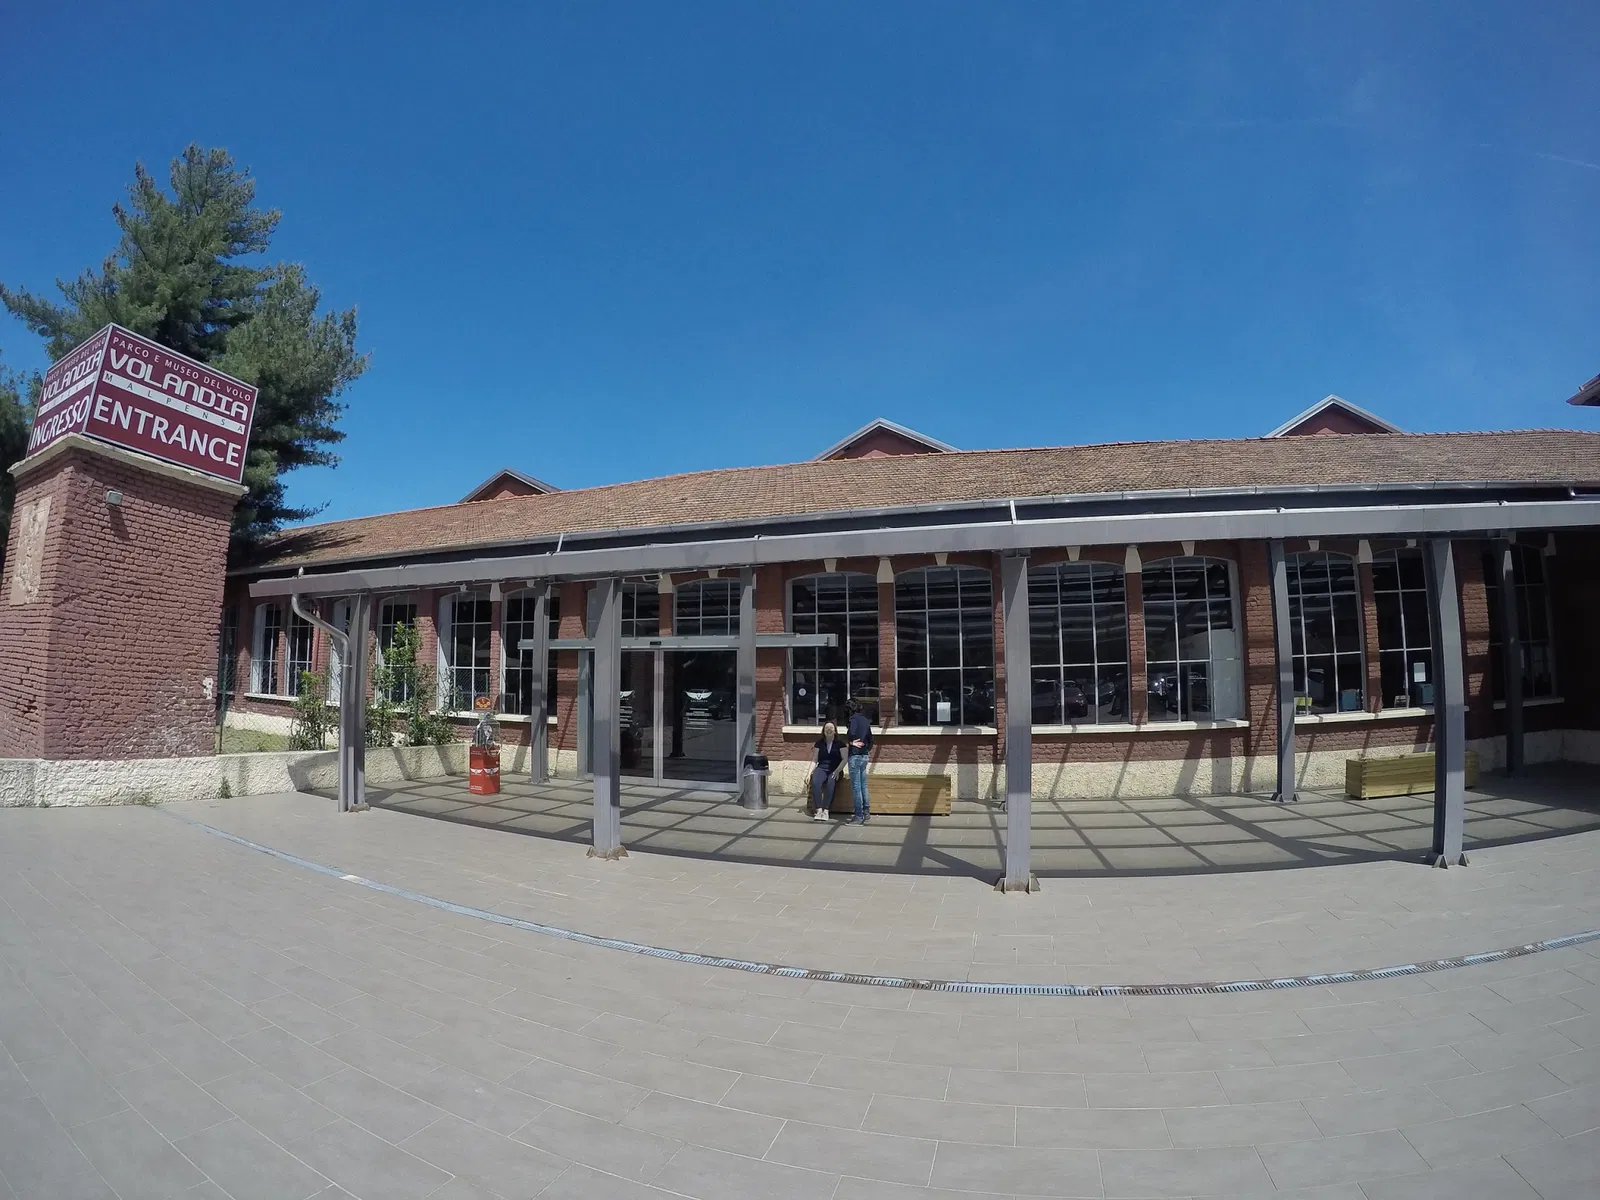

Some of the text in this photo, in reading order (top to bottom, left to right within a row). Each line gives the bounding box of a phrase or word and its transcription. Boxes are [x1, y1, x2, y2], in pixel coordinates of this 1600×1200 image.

[42, 349, 102, 402] VOLANDIA
[110, 347, 249, 422] VOLANDIA
[113, 336, 251, 402] PARCO E MUSEO DEL VOLO
[29, 395, 90, 451] INGRESSO
[93, 394, 242, 467] ENTRANCE
[105, 373, 243, 433] MALPENSA
